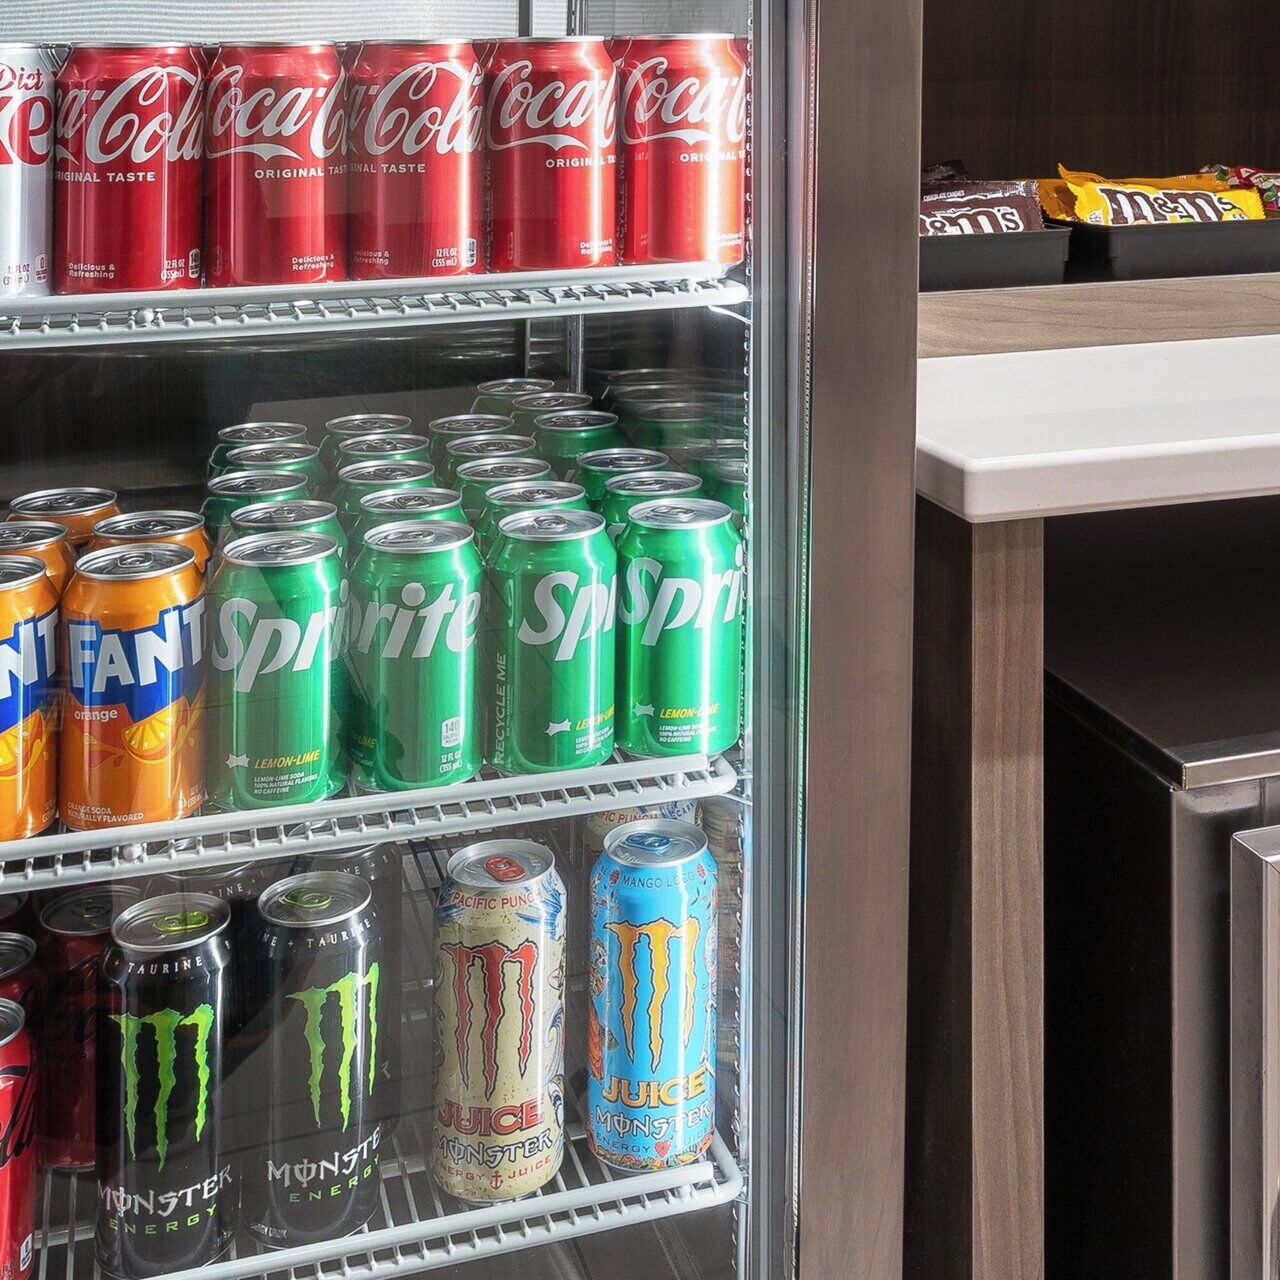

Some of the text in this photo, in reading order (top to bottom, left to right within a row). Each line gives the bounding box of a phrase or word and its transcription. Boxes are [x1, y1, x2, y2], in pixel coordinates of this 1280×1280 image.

[55, 172, 156, 182] RIGINAL TASTE
[381, 164, 426, 173] TASTE
[69, 270, 115, 278] Refreshing
[292, 256, 325, 264] Delicious
[618, 543, 742, 646] Spri
[211, 579, 349, 693] Spri
[350, 582, 482, 658] rite
[69, 596, 206, 692] FANT
[74, 708, 118, 722] orange
[494, 653, 506, 764] RECYCLE ME
[254, 750, 320, 769] LEMON-LIME
[622, 874, 663, 888] MANGO
[452, 890, 544, 909] PACIFIC PUNCH
[307, 918, 371, 949] TAURINE
[127, 956, 203, 975] TAURINE
[602, 1066, 707, 1110] JUICE
[439, 1093, 545, 1137] JUICE
[595, 1103, 711, 1142] MONSTER
[267, 1122, 381, 1188] MONSTE
[433, 1131, 553, 1168] MONSTER
[508, 1157, 552, 1179] JUICE
[97, 1164, 233, 1218] MONSTER
[109, 1203, 218, 1235] ENERGY
